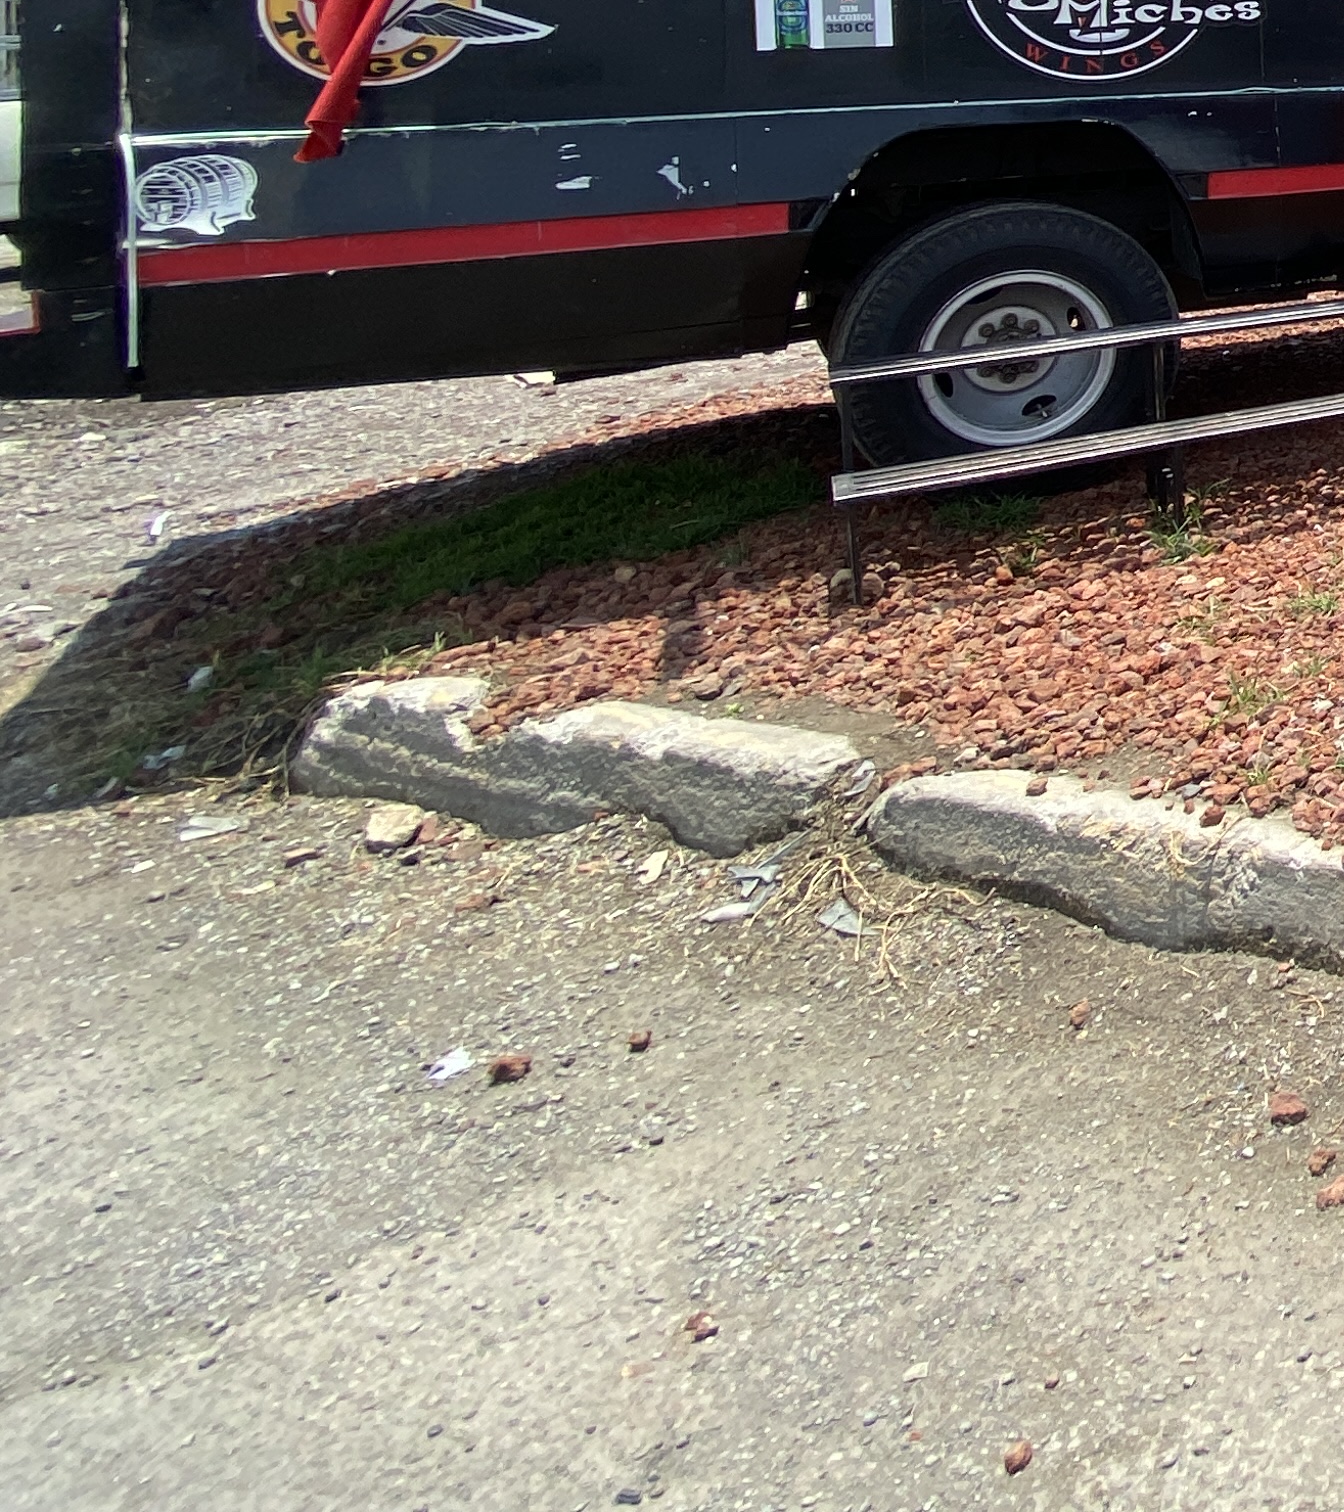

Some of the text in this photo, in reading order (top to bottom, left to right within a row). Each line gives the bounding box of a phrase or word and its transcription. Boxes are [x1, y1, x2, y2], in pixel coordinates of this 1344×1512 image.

[839, 5, 858, 13] SIN
[825, 13, 875, 23] ALCOHOL
[826, 22, 874, 33] 330 CC
[1025, 40, 1168, 74] WINGS
